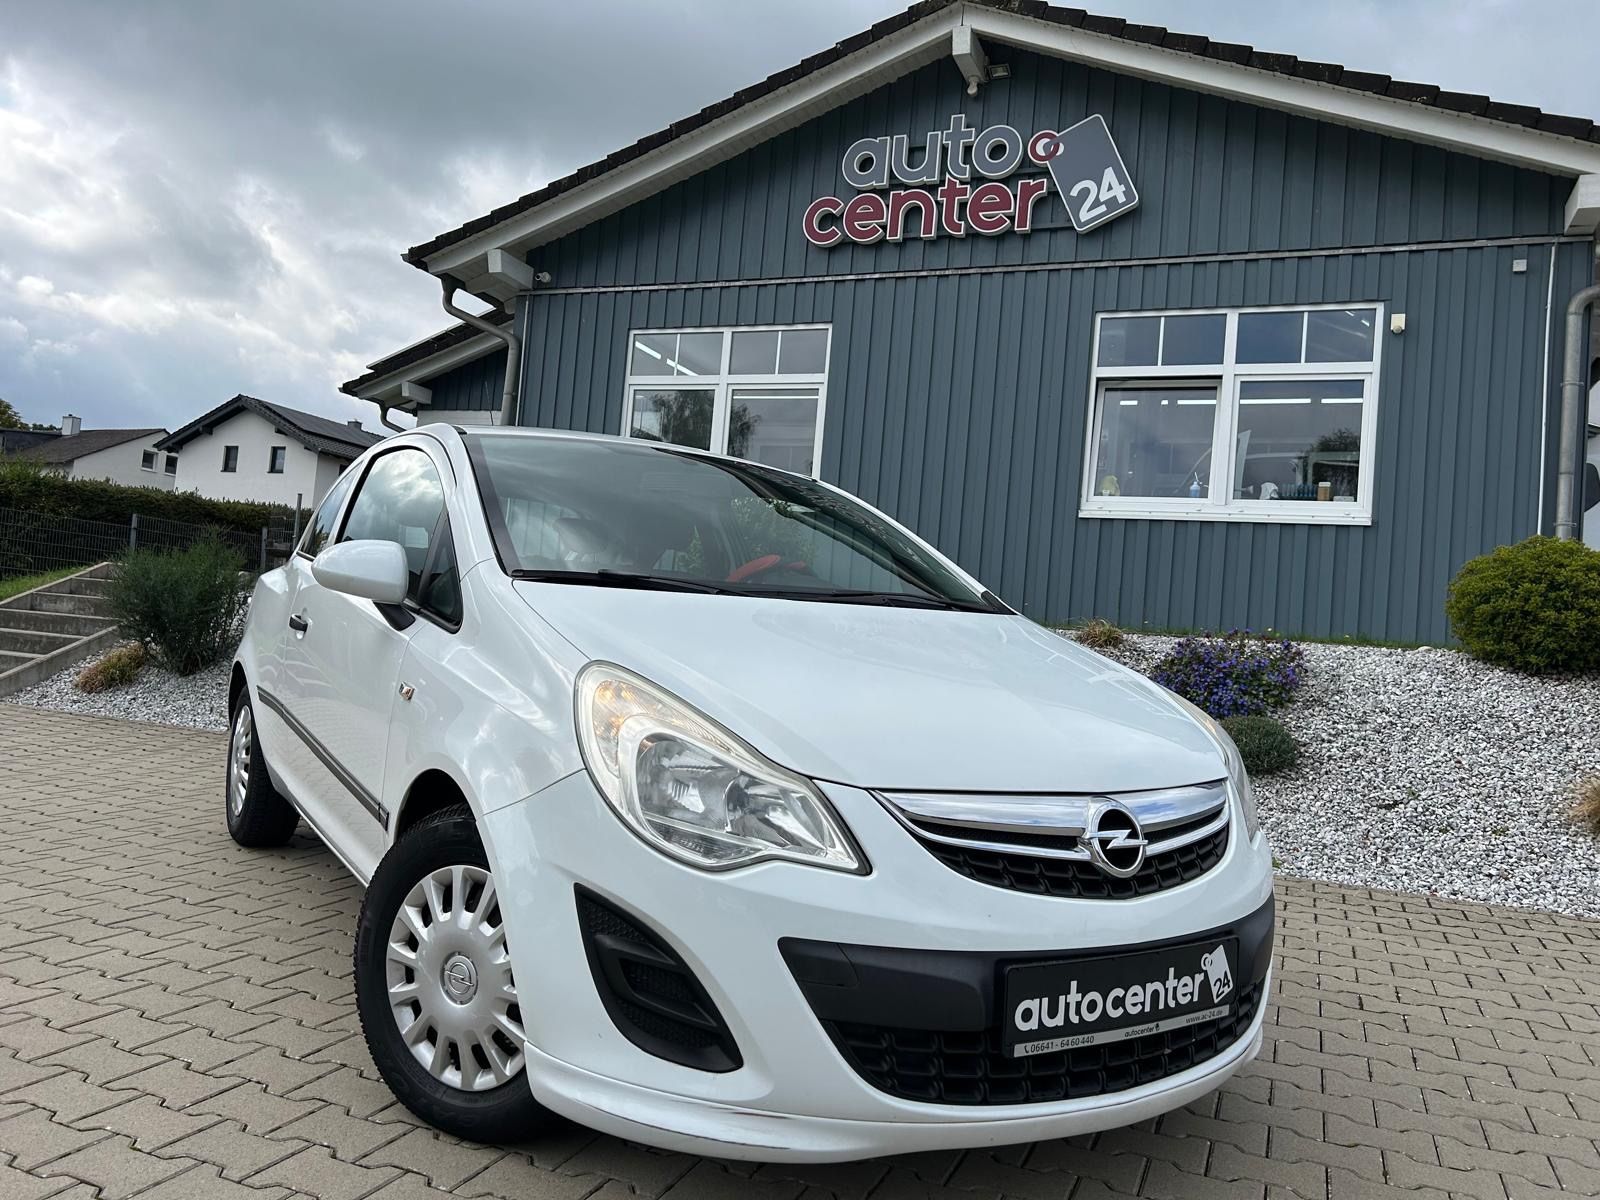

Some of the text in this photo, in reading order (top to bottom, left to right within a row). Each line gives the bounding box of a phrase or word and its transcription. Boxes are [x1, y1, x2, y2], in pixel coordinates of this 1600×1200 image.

[842, 114, 1024, 189] auto
[803, 174, 1047, 246] center
[1070, 167, 1126, 222] 24
[1014, 967, 1231, 1031] autocenter 24
[1030, 1042, 1053, 1053] 06641
[1124, 1025, 1154, 1037] autocenter
